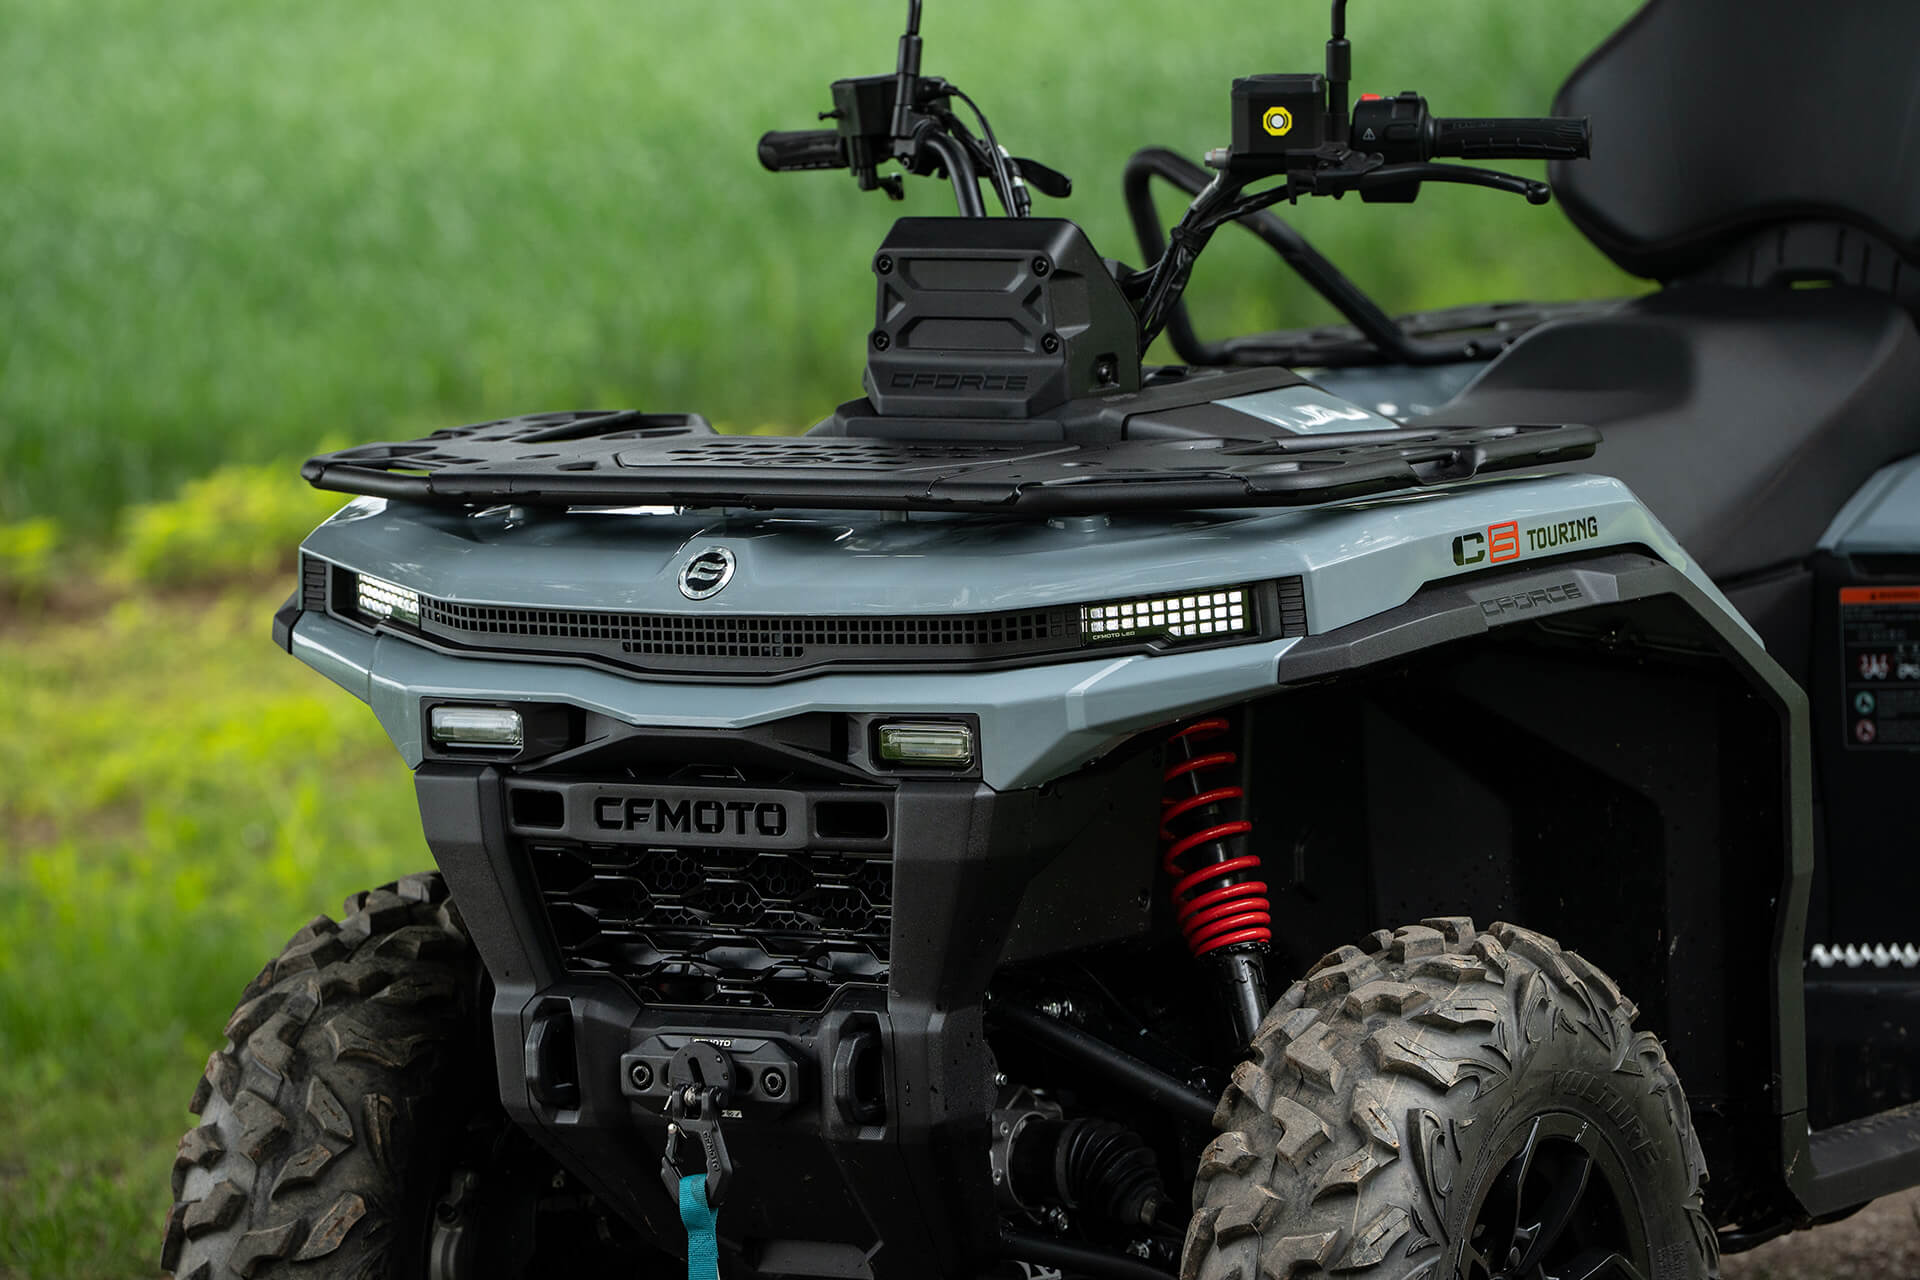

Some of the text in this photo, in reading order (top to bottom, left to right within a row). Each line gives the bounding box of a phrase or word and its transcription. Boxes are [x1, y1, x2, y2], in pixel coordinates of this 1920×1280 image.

[891, 372, 1028, 391] CFORCE
[1527, 516, 1598, 551] TOURING
[1480, 583, 1582, 616] CFORCE
[1092, 632, 1120, 640] CFMOTO
[593, 796, 787, 837] CFMOTO
